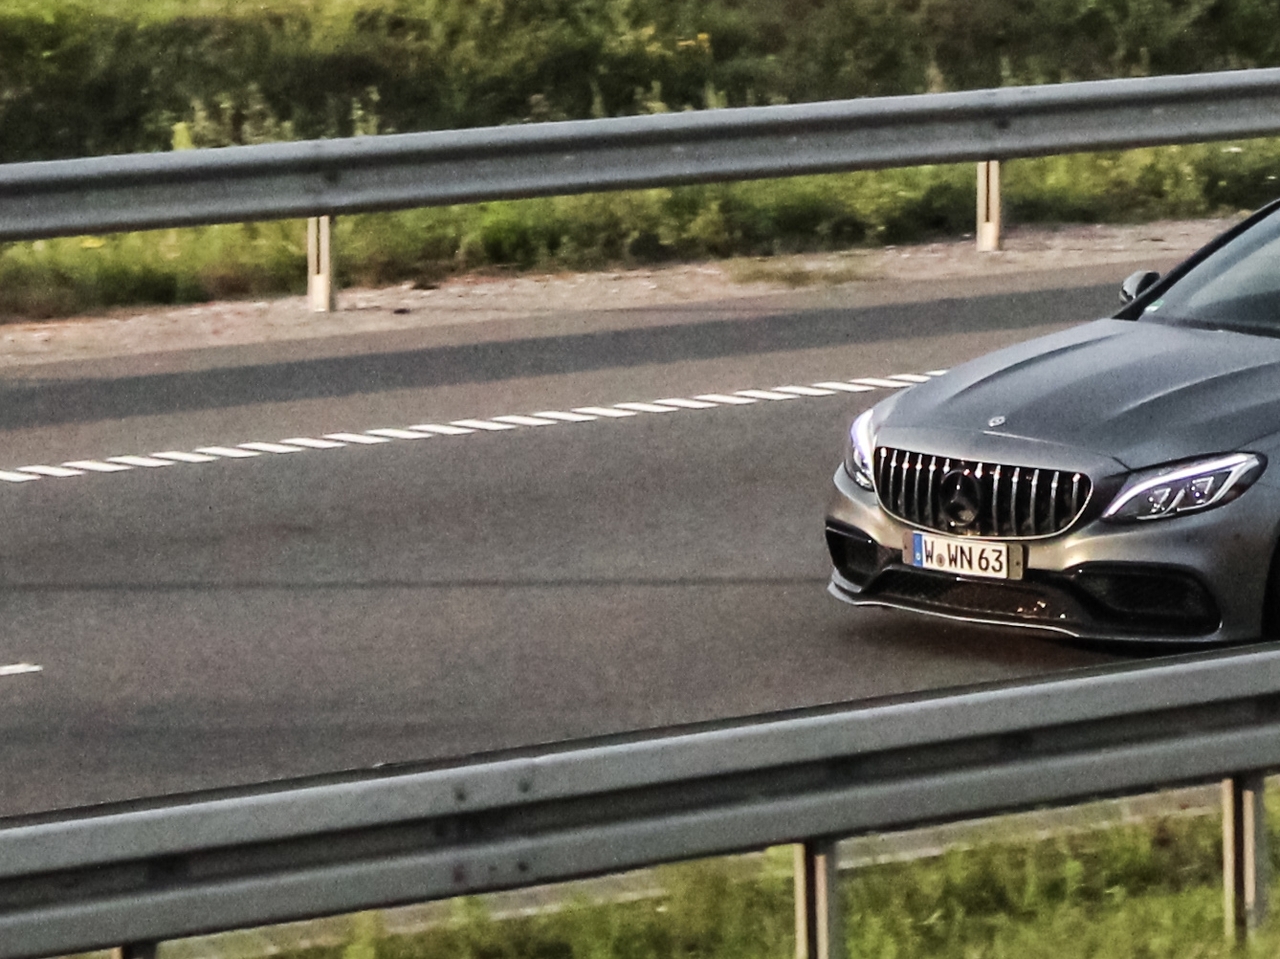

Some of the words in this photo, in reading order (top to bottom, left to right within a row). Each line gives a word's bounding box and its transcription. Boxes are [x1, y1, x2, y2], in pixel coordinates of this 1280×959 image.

[924, 540, 934, 564] W
[947, 543, 973, 570] WN
[978, 548, 1003, 572] 63
